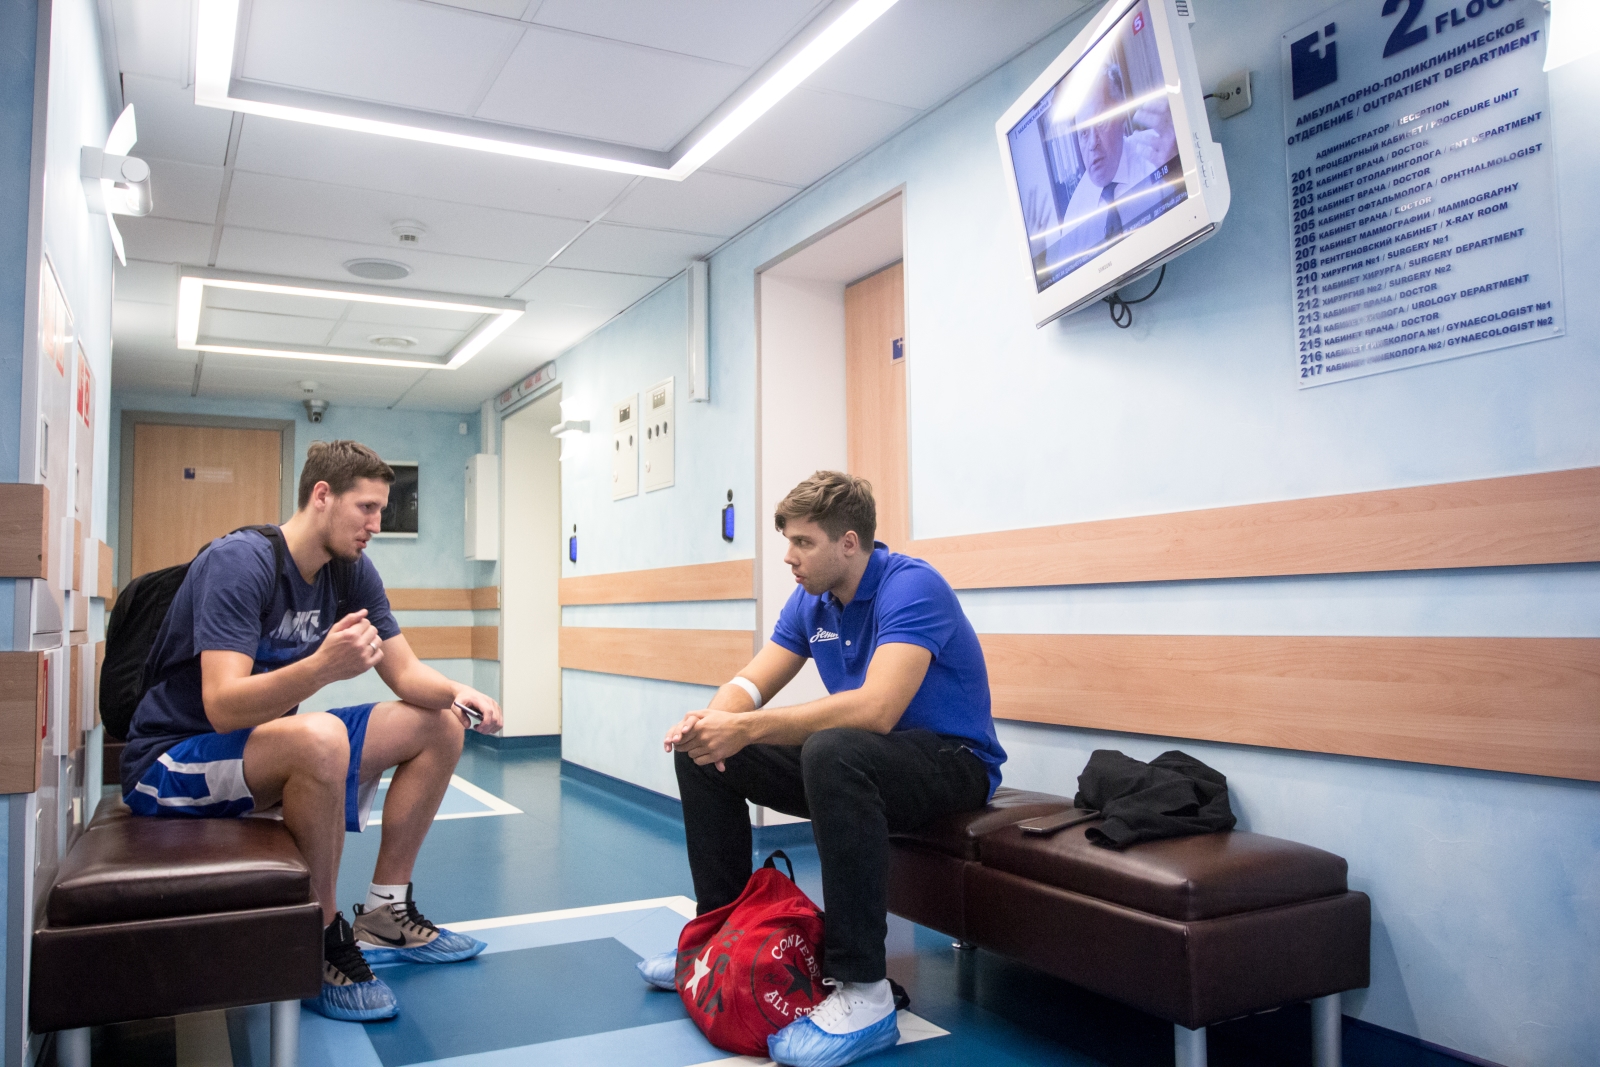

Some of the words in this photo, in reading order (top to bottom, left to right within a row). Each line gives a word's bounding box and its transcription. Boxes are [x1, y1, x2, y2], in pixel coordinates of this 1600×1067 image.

[1134, 15, 1142, 31] 5
[1381, 0, 1428, 58] 2
[1287, 109, 1353, 147] ОТДЕЛЕНИЕ
[1362, 72, 1439, 113] OUTPATIENT
[1444, 29, 1540, 78] DEPARTMENT
[1295, 17, 1525, 127] АМБУЛАТОРНО-ПОЛИКЛИНИЧЕСКОЕ
[1291, 166, 1311, 183] 201
[1315, 141, 1378, 175] ПРОЦЕДУРНЫЙ
[1493, 87, 1518, 104] UNIT
[1315, 123, 1389, 160] АДМИНИСТРАТОР
[1397, 99, 1449, 126] RECEPTION
[1154, 165, 1169, 181] 10:18
[1291, 179, 1313, 197] 202
[1316, 167, 1353, 187] КАБИНЕТ
[1355, 155, 1384, 172] ВРАЧА
[1391, 138, 1428, 158] DOCTOR
[1292, 192, 1313, 209] 203
[1316, 180, 1354, 200] КАБИНЕТ
[1356, 148, 1441, 185] ОТОЛАРИНГОЛОГА
[1471, 111, 1541, 143] DEPARTMENT
[1293, 218, 1315, 235] 205
[1318, 207, 1355, 227] КАБИНЕТ
[1357, 180, 1432, 213] ОФТАЛЬМОЛОГА
[1440, 142, 1542, 184] OPHTHALMOLOGIST
[1293, 205, 1314, 222] 204
[1317, 194, 1355, 213] КАБИНЕТ
[1357, 182, 1385, 199] ВРАЧА
[1392, 166, 1430, 186] DOCTOR
[1294, 244, 1316, 261] 207
[1319, 234, 1357, 253] КАБИНЕТ
[1359, 210, 1430, 240] МАММОГРАФИИ
[1437, 181, 1518, 214] MAMMOGRAPHY
[1294, 231, 1315, 248] 206
[1318, 221, 1356, 239] КАБИНЕТ
[1358, 210, 1387, 226] ВРАЧА
[1394, 195, 1431, 214] DOCTOR
[1295, 257, 1317, 274] 208
[1319, 235, 1392, 266] РЕНТГЕНОВСКИЙ
[1394, 222, 1437, 242] КАБИНЕТ
[1445, 211, 1474, 227] X-RAY
[1477, 201, 1507, 217] ROOM
[1296, 270, 1317, 286] 210
[1320, 261, 1362, 279] ХИРУРГИЯ
[1387, 240, 1429, 259] SURGERY
[1296, 284, 1318, 300] 211
[1321, 275, 1359, 292] КАБИНЕТ
[1362, 263, 1401, 281] ХИРУРГА
[1408, 248, 1452, 267] SURGERY
[1455, 227, 1524, 254] DEPARTMENT
[1297, 297, 1319, 313] 212
[1322, 288, 1363, 306] ХИРУРГИЯ
[1389, 269, 1431, 287] SURGERY
[1298, 310, 1319, 325] 213
[1322, 302, 1361, 319] КАБИНЕТ
[1363, 294, 1392, 308] ВРАЧА
[1399, 282, 1437, 299] DOCTOR
[1298, 323, 1320, 339] 214
[1323, 316, 1361, 332] КАБИНЕ
[1411, 291, 1457, 310] UROLOGY
[1460, 273, 1529, 298] DEPARTMENT
[1299, 337, 1321, 352] 215
[1324, 330, 1362, 346] КАБИНЕТ
[1364, 322, 1393, 336] ВРАЧА
[1401, 311, 1439, 327] DOCTOR
[1300, 350, 1322, 364] 216
[1446, 304, 1533, 331] GYNAECOLOGIST
[1300, 363, 1322, 378] 217
[1447, 320, 1534, 346] GYNAECOLOGIST
[771, 934, 821, 980] CONVERSE
[765, 989, 790, 1016] ALL
